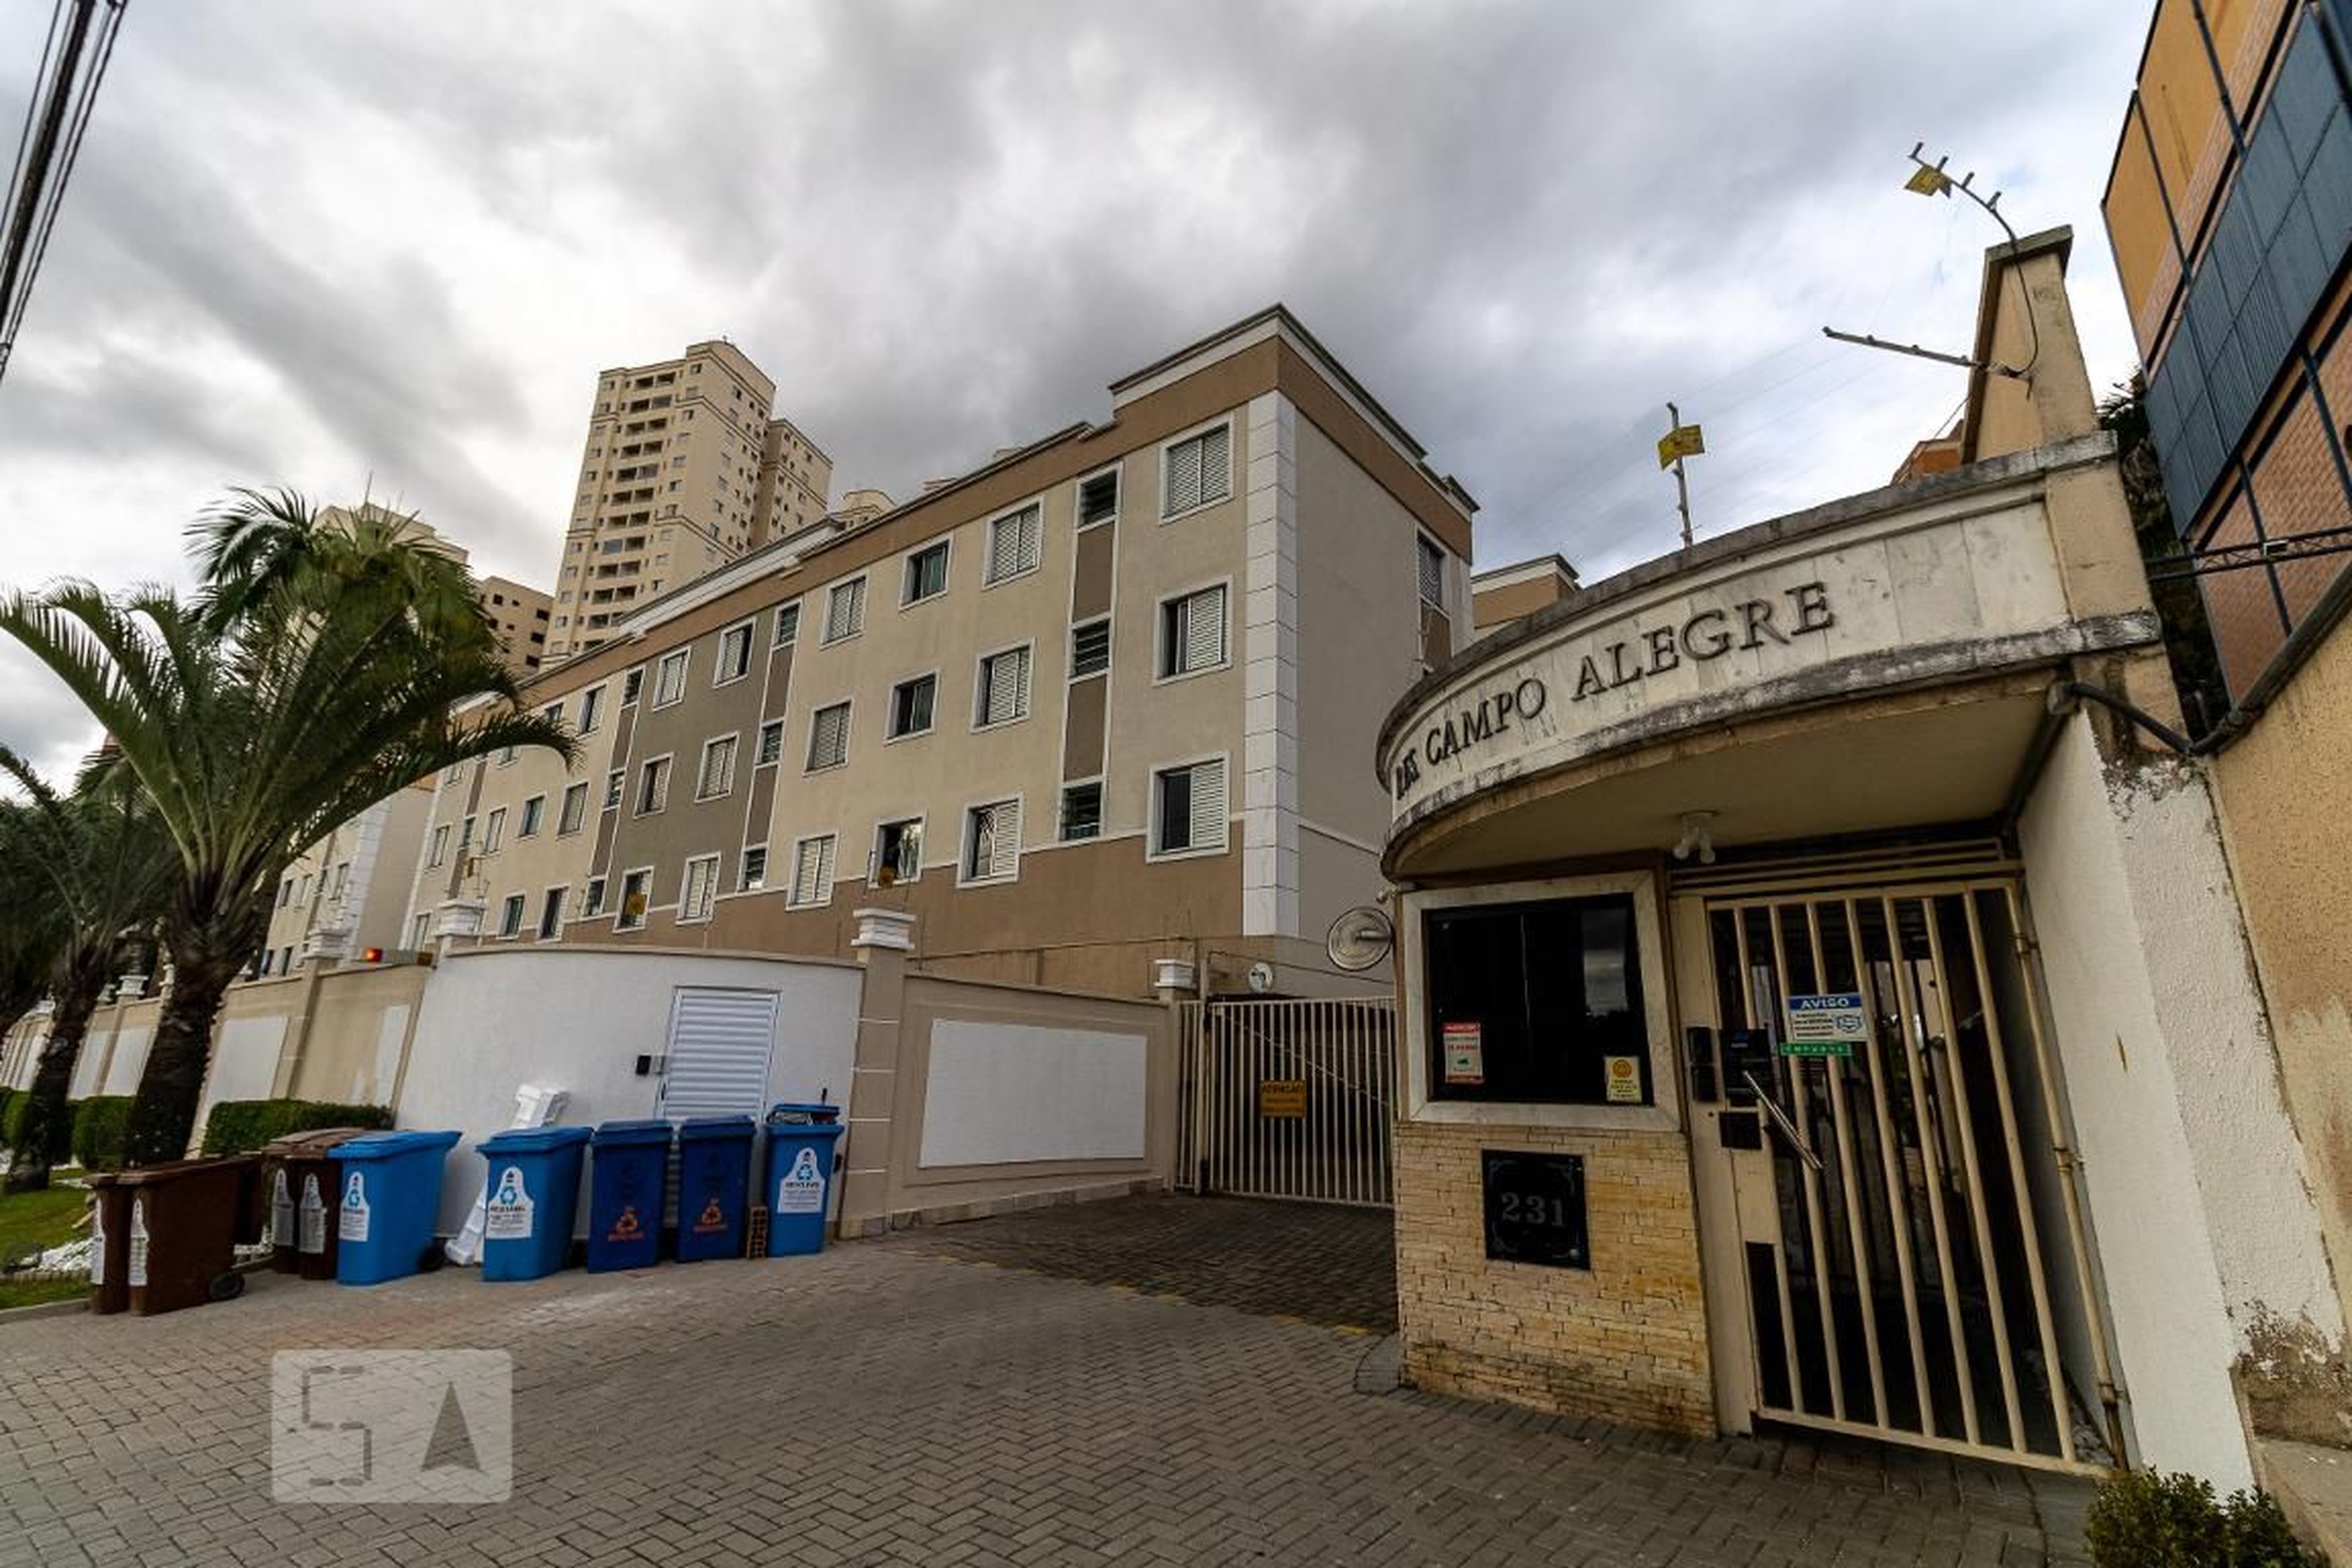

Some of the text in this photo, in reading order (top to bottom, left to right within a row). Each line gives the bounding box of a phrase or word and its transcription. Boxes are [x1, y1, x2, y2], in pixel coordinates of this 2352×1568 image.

[1426, 677, 1546, 766] CAMPO
[1572, 581, 1834, 701] ALEGRE
[1800, 997, 1850, 1010] AVISO
[1501, 1191, 1567, 1227] 231
